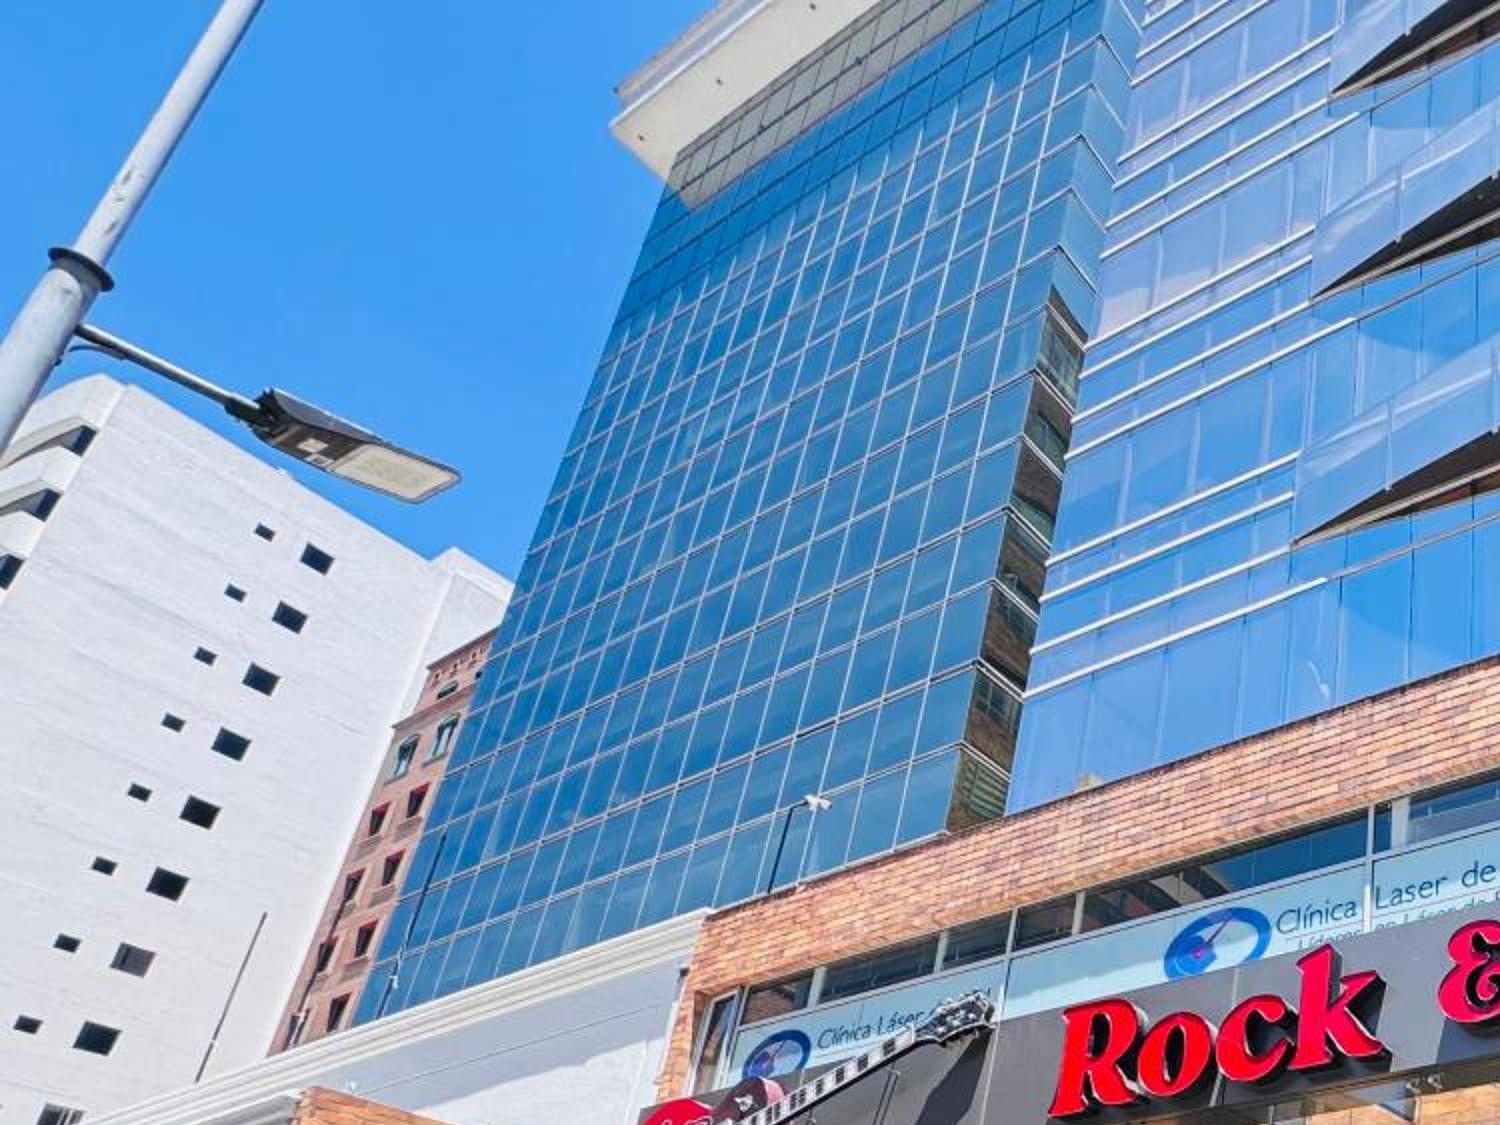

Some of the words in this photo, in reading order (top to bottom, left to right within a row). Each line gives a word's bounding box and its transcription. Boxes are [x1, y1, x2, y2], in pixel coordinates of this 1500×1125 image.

[1276, 898, 1358, 935] Clínica
[1375, 877, 1448, 909] Laser
[1461, 860, 1497, 889] de
[818, 1024, 871, 1049] Clínica
[1046, 942, 1386, 1119] Rock
